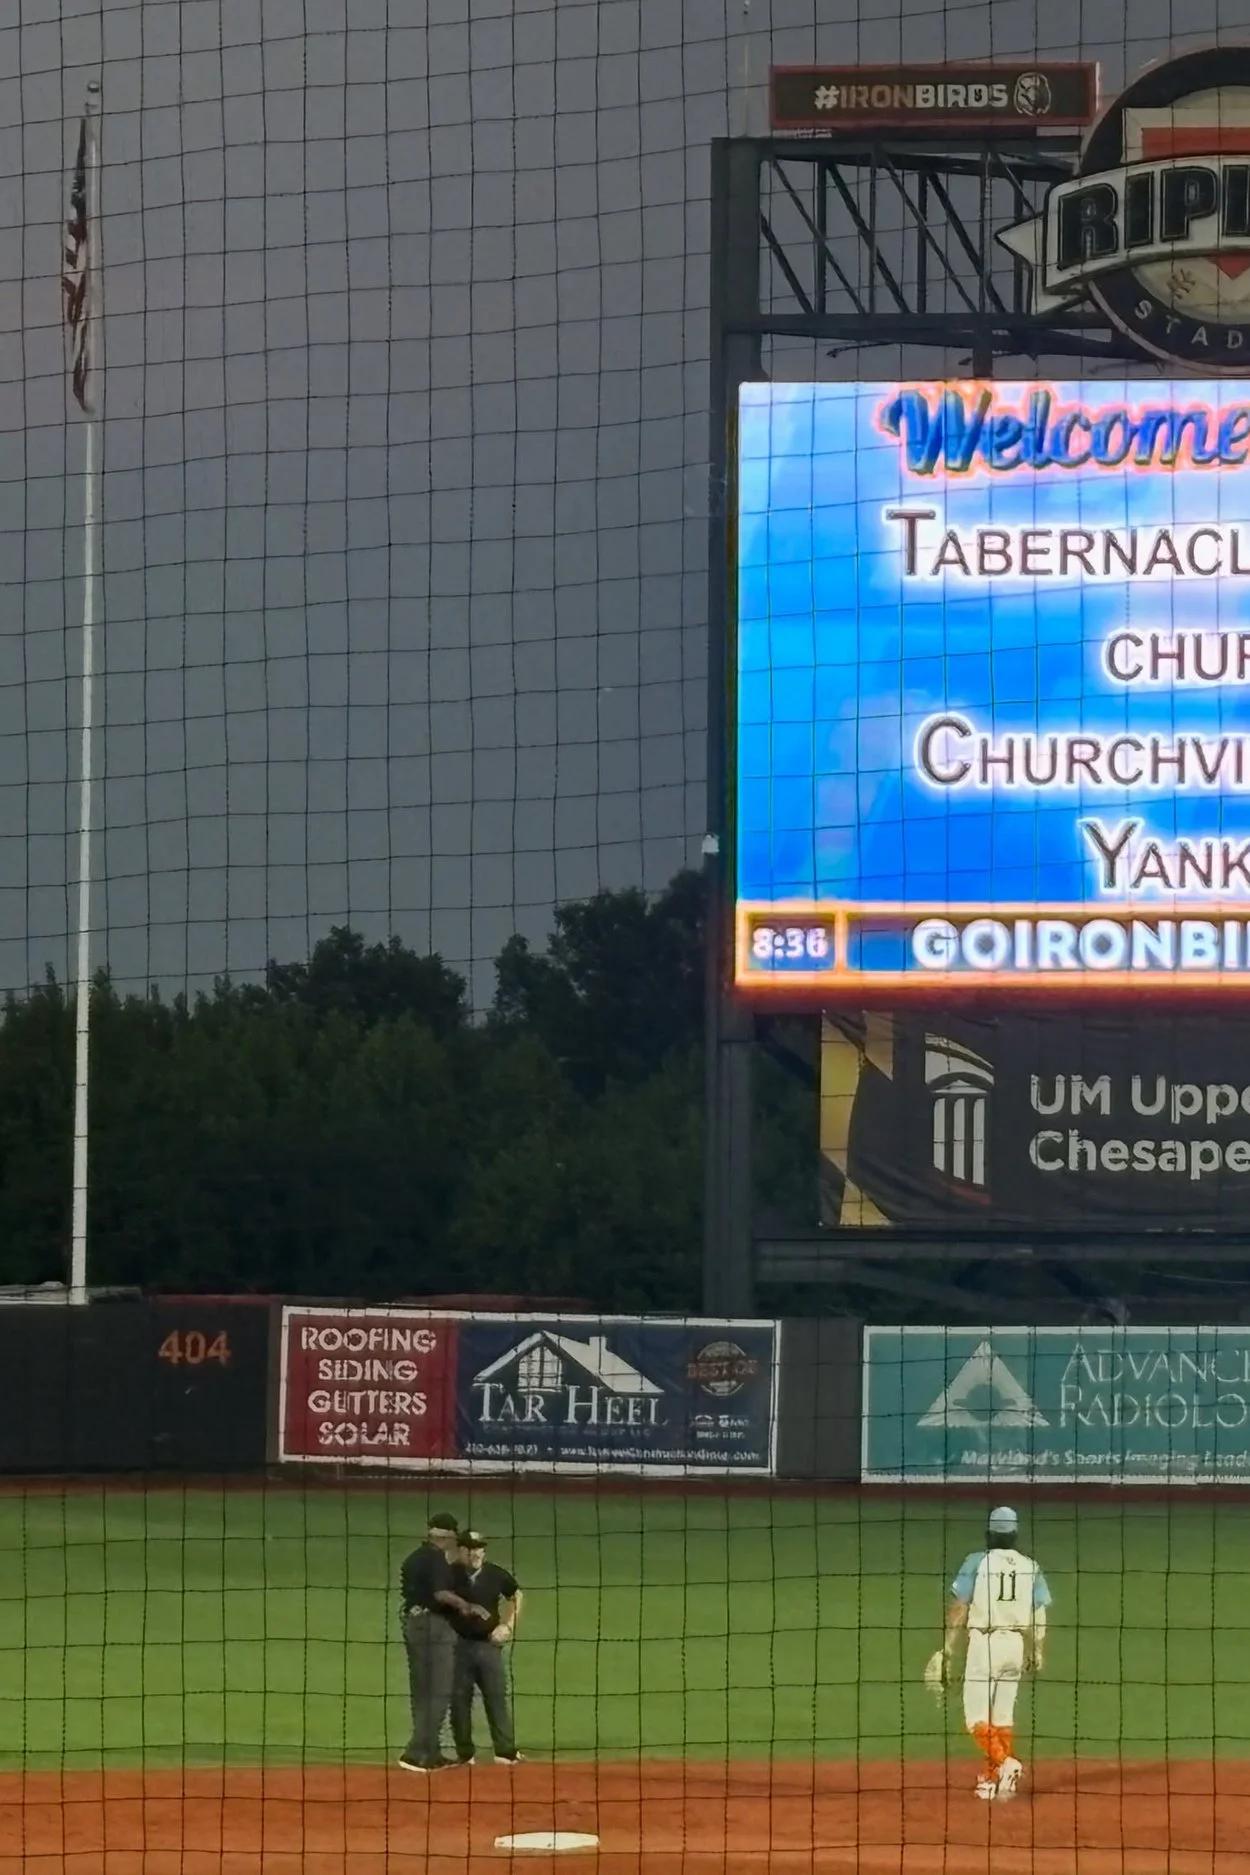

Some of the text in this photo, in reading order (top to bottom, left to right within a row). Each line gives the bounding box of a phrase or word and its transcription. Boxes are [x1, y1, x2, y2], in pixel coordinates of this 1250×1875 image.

[813, 83, 1008, 109] #IRONBIRDS
[1029, 1074, 1112, 1117] UM
[157, 1330, 232, 1366] 404
[301, 1326, 437, 1354] ROOFING
[317, 1358, 419, 1382] SIDING
[306, 1389, 428, 1416] GUTTERS
[472, 1382, 549, 1423] TAR
[317, 1421, 411, 1447] SOLAR
